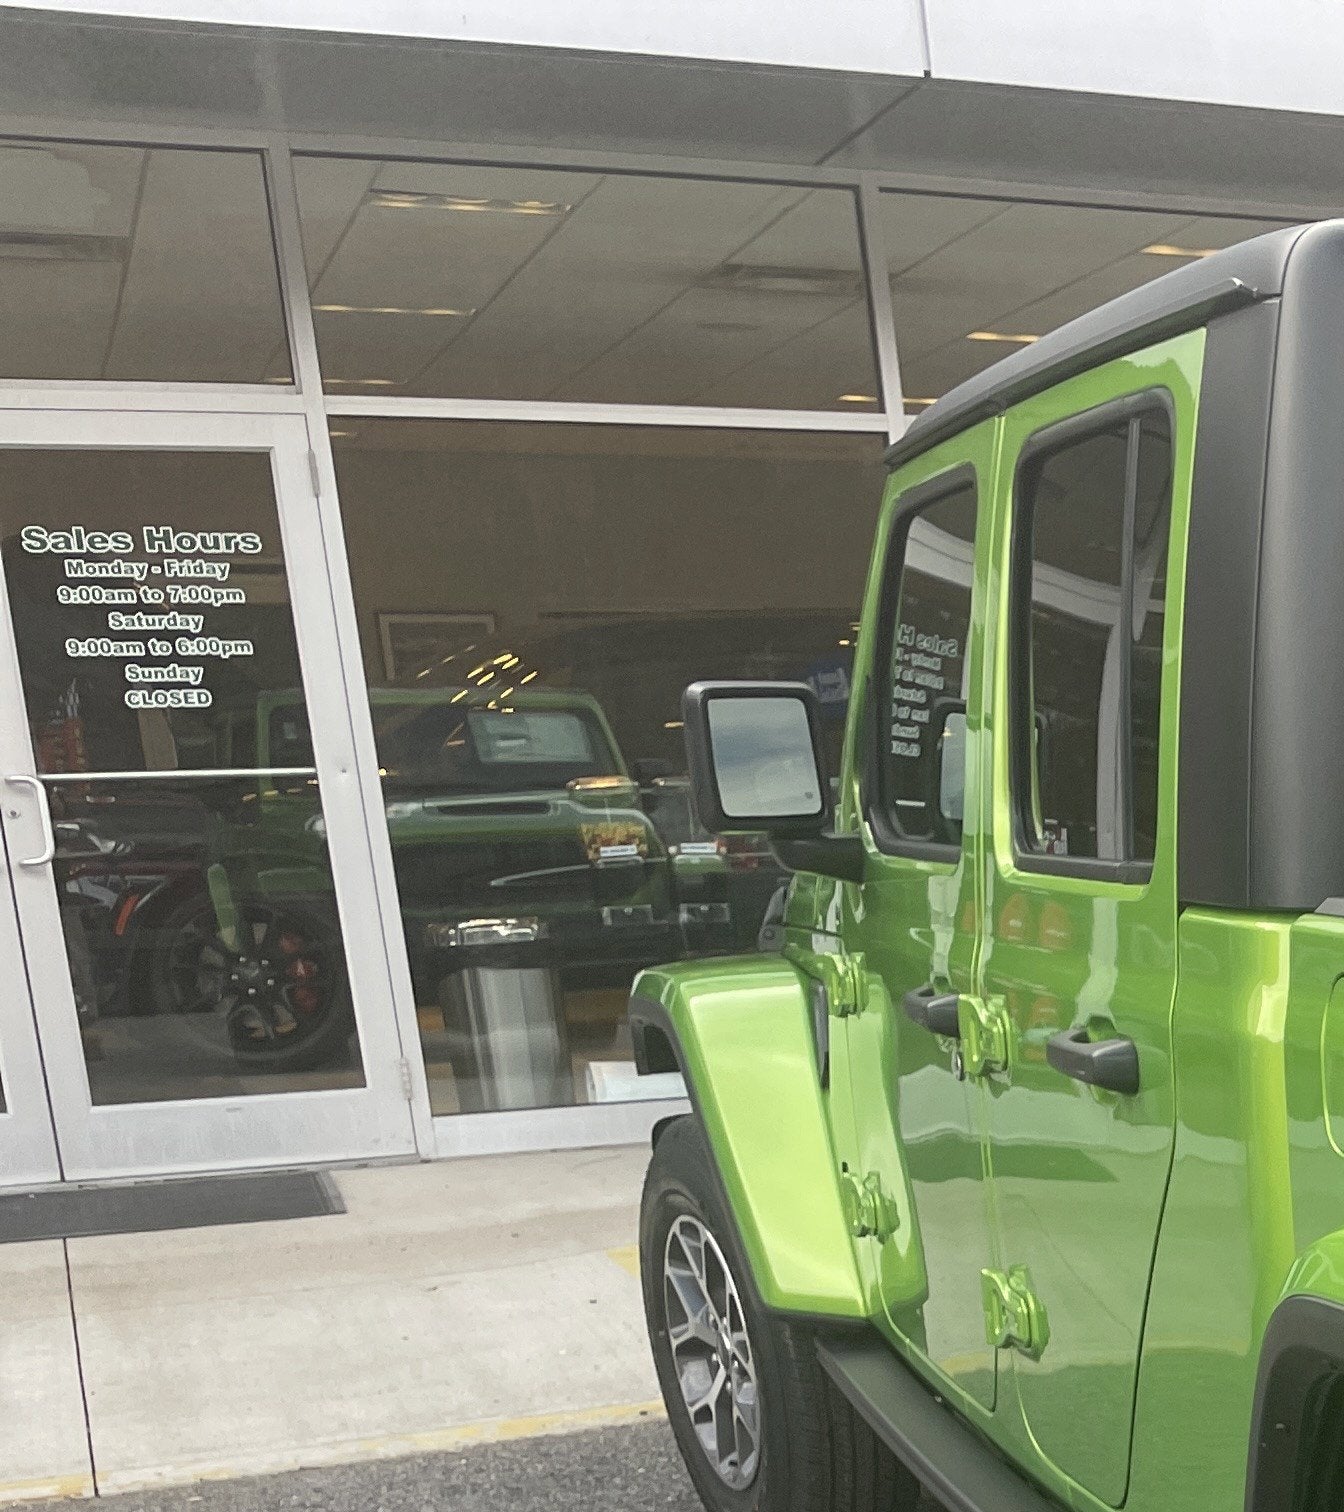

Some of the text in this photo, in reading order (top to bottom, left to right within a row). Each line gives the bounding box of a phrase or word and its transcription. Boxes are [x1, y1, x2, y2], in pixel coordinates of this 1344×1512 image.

[22, 526, 262, 553] Sales Hours
[64, 559, 148, 580] Monday
[164, 559, 230, 580] Friday
[57, 586, 245, 606] 9:00am to 7:00pm
[108, 612, 204, 632] Saturday
[66, 638, 253, 658] 9:00am to 6:00pm
[125, 664, 203, 684] Sunday
[125, 690, 212, 708] CLOSED
